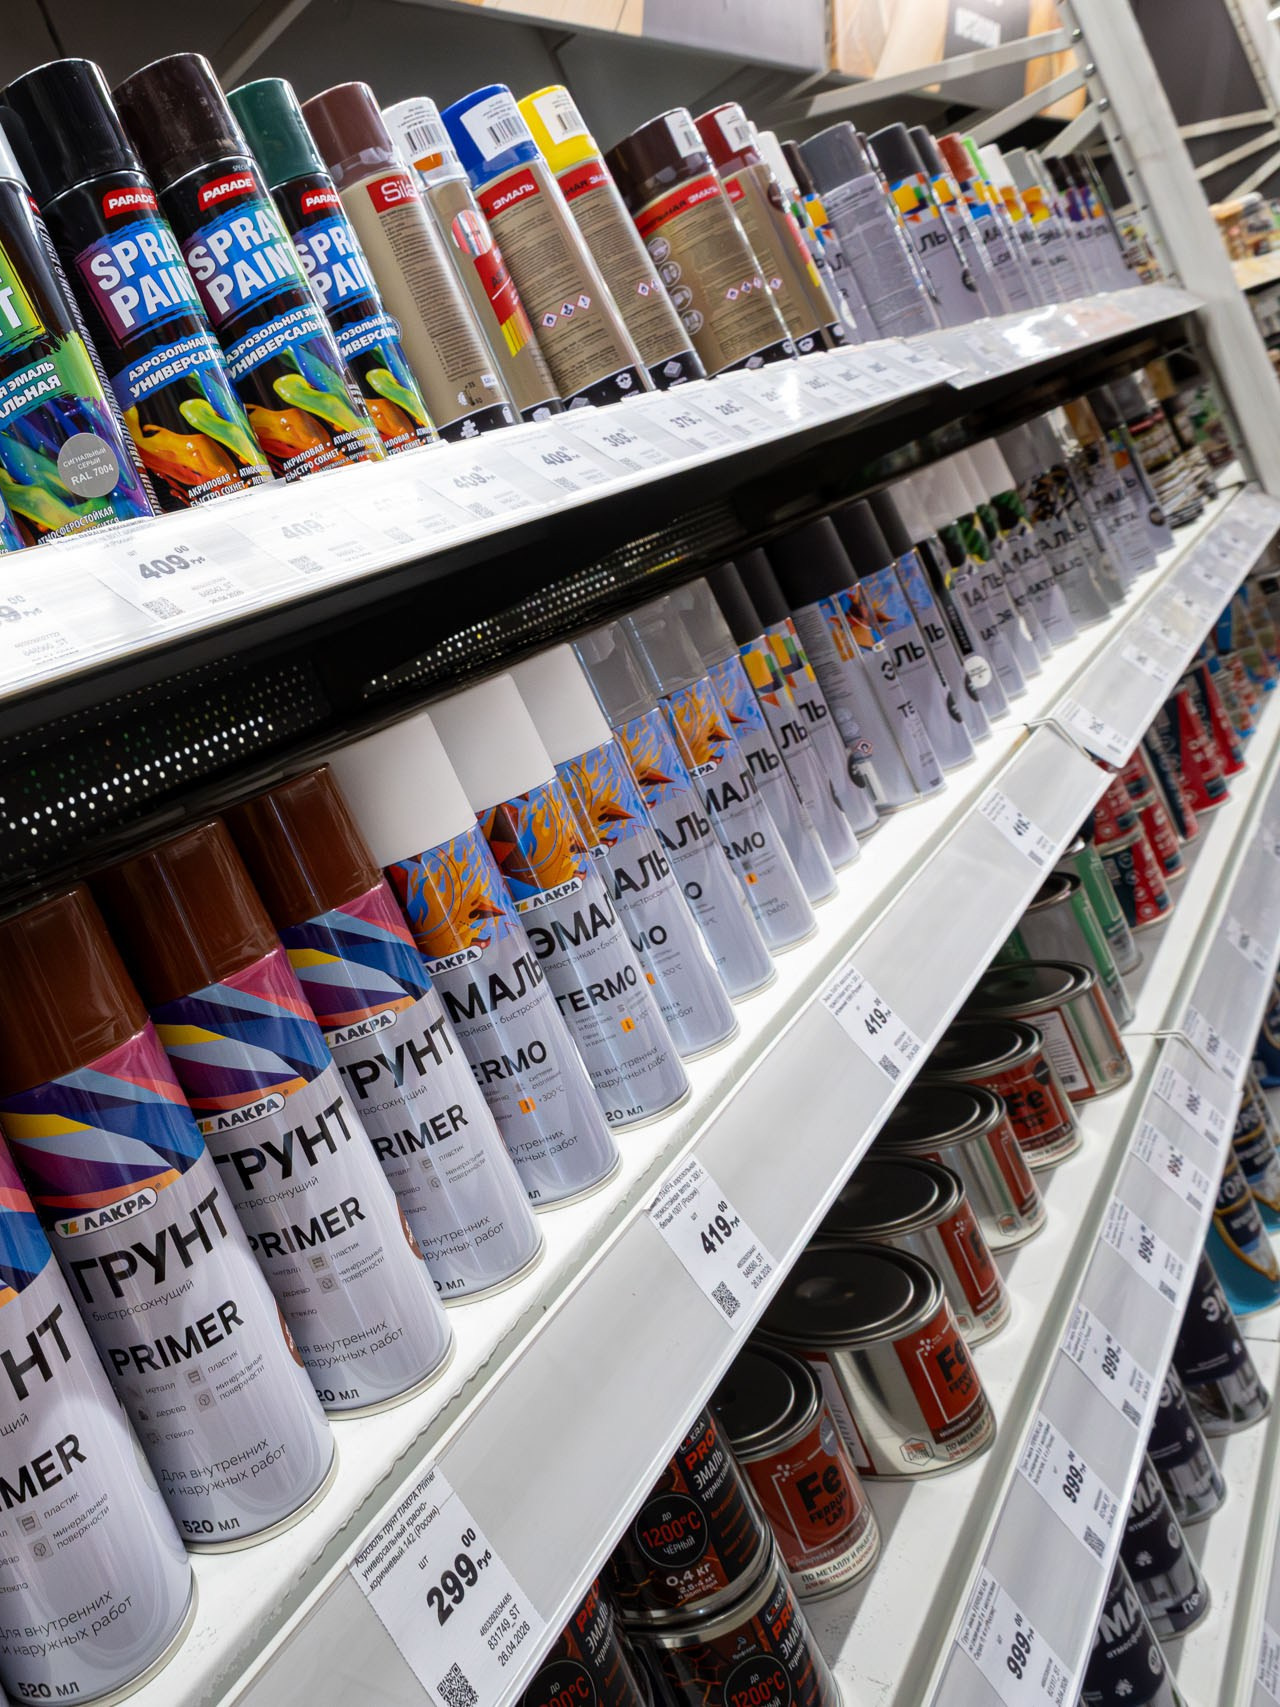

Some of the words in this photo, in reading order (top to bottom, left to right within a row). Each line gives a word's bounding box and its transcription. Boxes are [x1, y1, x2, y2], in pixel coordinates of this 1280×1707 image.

[108, 194, 156, 210] PARADE
[202, 177, 253, 203] PARADE
[492, 182, 536, 211] ЭМАЛЬ
[7, 360, 56, 391] ЭМАЛЬ
[77, 457, 102, 472] СЕРЫЙ
[283, 444, 325, 471] АКРИЛОВАЯ
[285, 459, 315, 482] БЫСТРО
[314, 447, 340, 469] СОХНЕТ
[540, 450, 573, 467] 409
[70, 470, 92, 488] RAL
[91, 463, 115, 481] 7004
[188, 472, 231, 499] АКРИЛОВАЯ
[451, 470, 487, 490] 409
[280, 517, 322, 541] 409
[137, 552, 192, 581] 409
[532, 880, 581, 909] ЛАКРА
[334, 1014, 393, 1045] ЛАКРА
[864, 1007, 888, 1036] 419
[216, 1099, 280, 1130] ЛАКРА
[605, 1109, 624, 1123] 20
[626, 1104, 644, 1117] мл
[84, 1193, 152, 1233] ЛАКРА
[700, 1215, 732, 1254] 419
[717, 1200, 729, 1213] 00
[69, 1186, 231, 1305] ГРУНТ
[91, 1279, 195, 1323] быстросохнущий
[109, 1299, 245, 1377] PRIMER
[314, 1321, 389, 1354] внутренних
[373, 1326, 405, 1355] работ
[206, 1350, 240, 1376] пластик
[1101, 1346, 1121, 1381] 999
[337, 1387, 360, 1402] мл
[160, 1467, 189, 1484] Для
[189, 1437, 270, 1482] внутренних
[179, 1467, 250, 1498] наружных
[251, 1443, 288, 1478] работ
[796, 1464, 842, 1512] Fe
[1062, 1464, 1084, 1504] 999
[43, 1491, 81, 1521] пластик
[51, 1492, 110, 1542] минеральные
[354, 1527, 385, 1568] Аэрозоль
[398, 1488, 419, 1519] ЛАКРА
[417, 1471, 437, 1496] Primer
[56, 1504, 111, 1551] поверхности
[181, 1518, 216, 1535] 520
[218, 1517, 241, 1533] мл
[361, 1523, 408, 1581] универсальный
[369, 1545, 406, 1591] коричневый
[414, 1506, 441, 1539] (Россия)
[476, 1549, 493, 1571] Руб
[426, 1552, 480, 1627] 299
[461, 1527, 477, 1548] 00
[696, 1563, 712, 1578] кг
[800, 1573, 816, 1584] ПО
[816, 1555, 852, 1579] МЕТАЛЛУ
[12, 1627, 90, 1657] наружных
[91, 1595, 133, 1637] работ
[24, 1590, 114, 1638] внутренних
[487, 1603, 521, 1651] 831749_ST
[497, 1622, 531, 1667] 26.04.2026
[1006, 1630, 1031, 1680] 999
[17, 1681, 52, 1698] 520
[56, 1681, 80, 1696] мл
